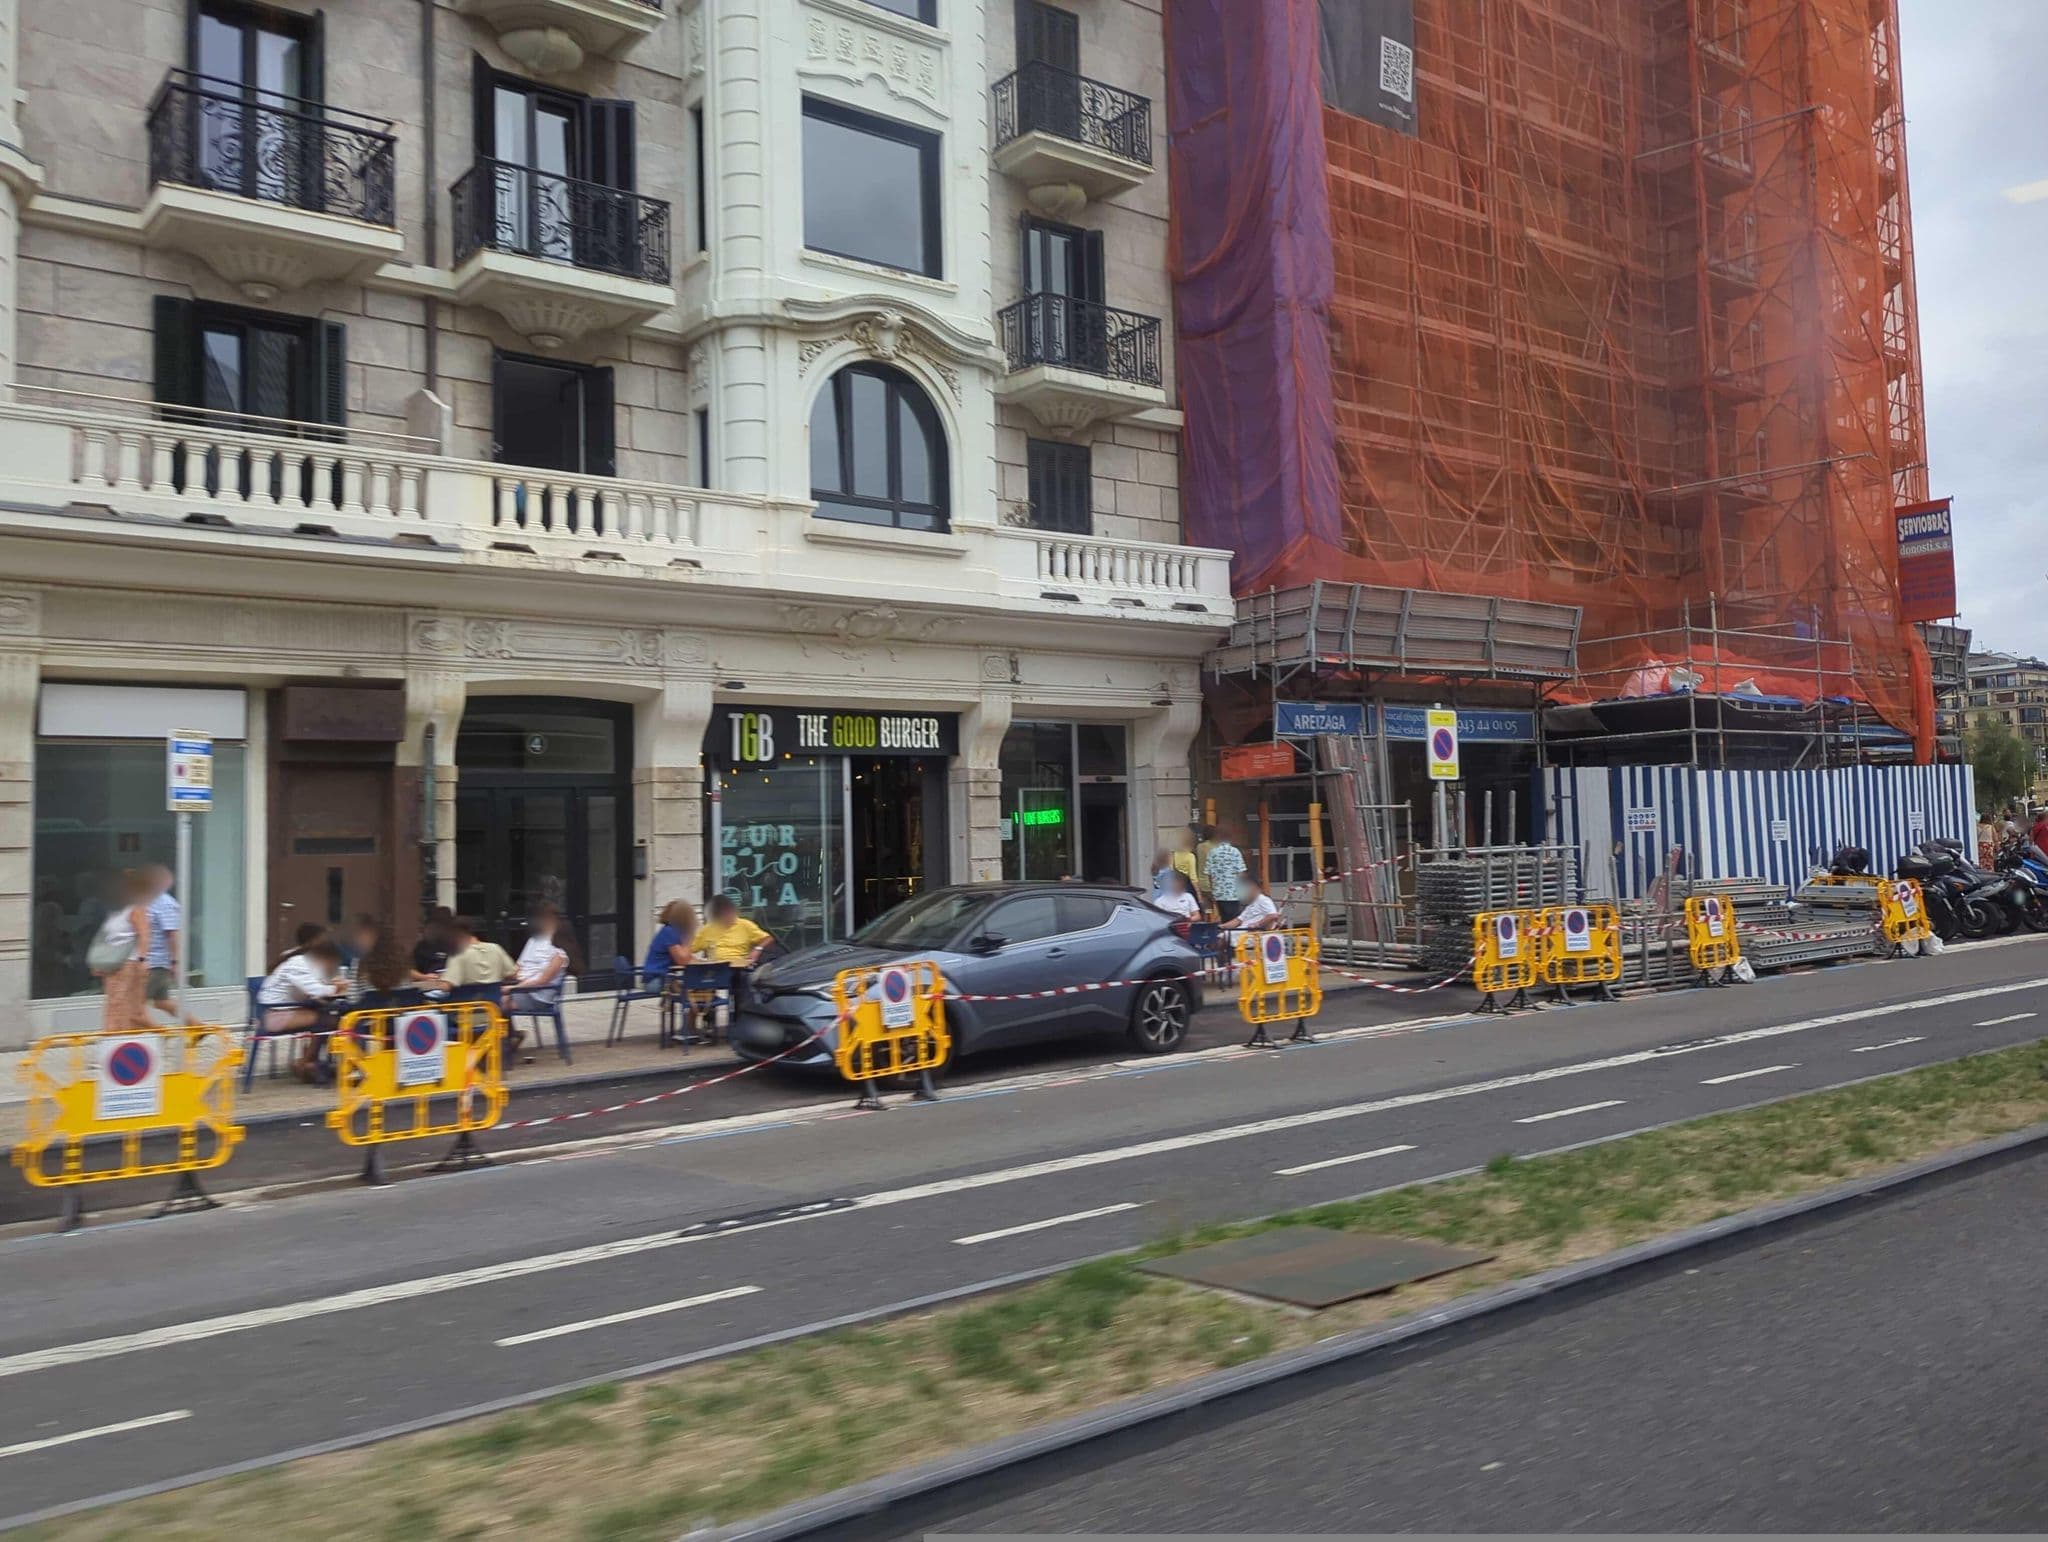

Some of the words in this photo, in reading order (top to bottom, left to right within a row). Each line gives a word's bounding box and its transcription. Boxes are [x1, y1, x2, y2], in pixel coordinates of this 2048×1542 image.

[1898, 511, 1949, 541] SERVIOBRAS
[728, 713, 774, 761] TGB
[796, 714, 829, 747] THE
[832, 715, 876, 748] GOOD
[880, 717, 940, 749] BURGER
[1294, 714, 1346, 730] AREIZAGA
[1457, 719, 1475, 734] 943
